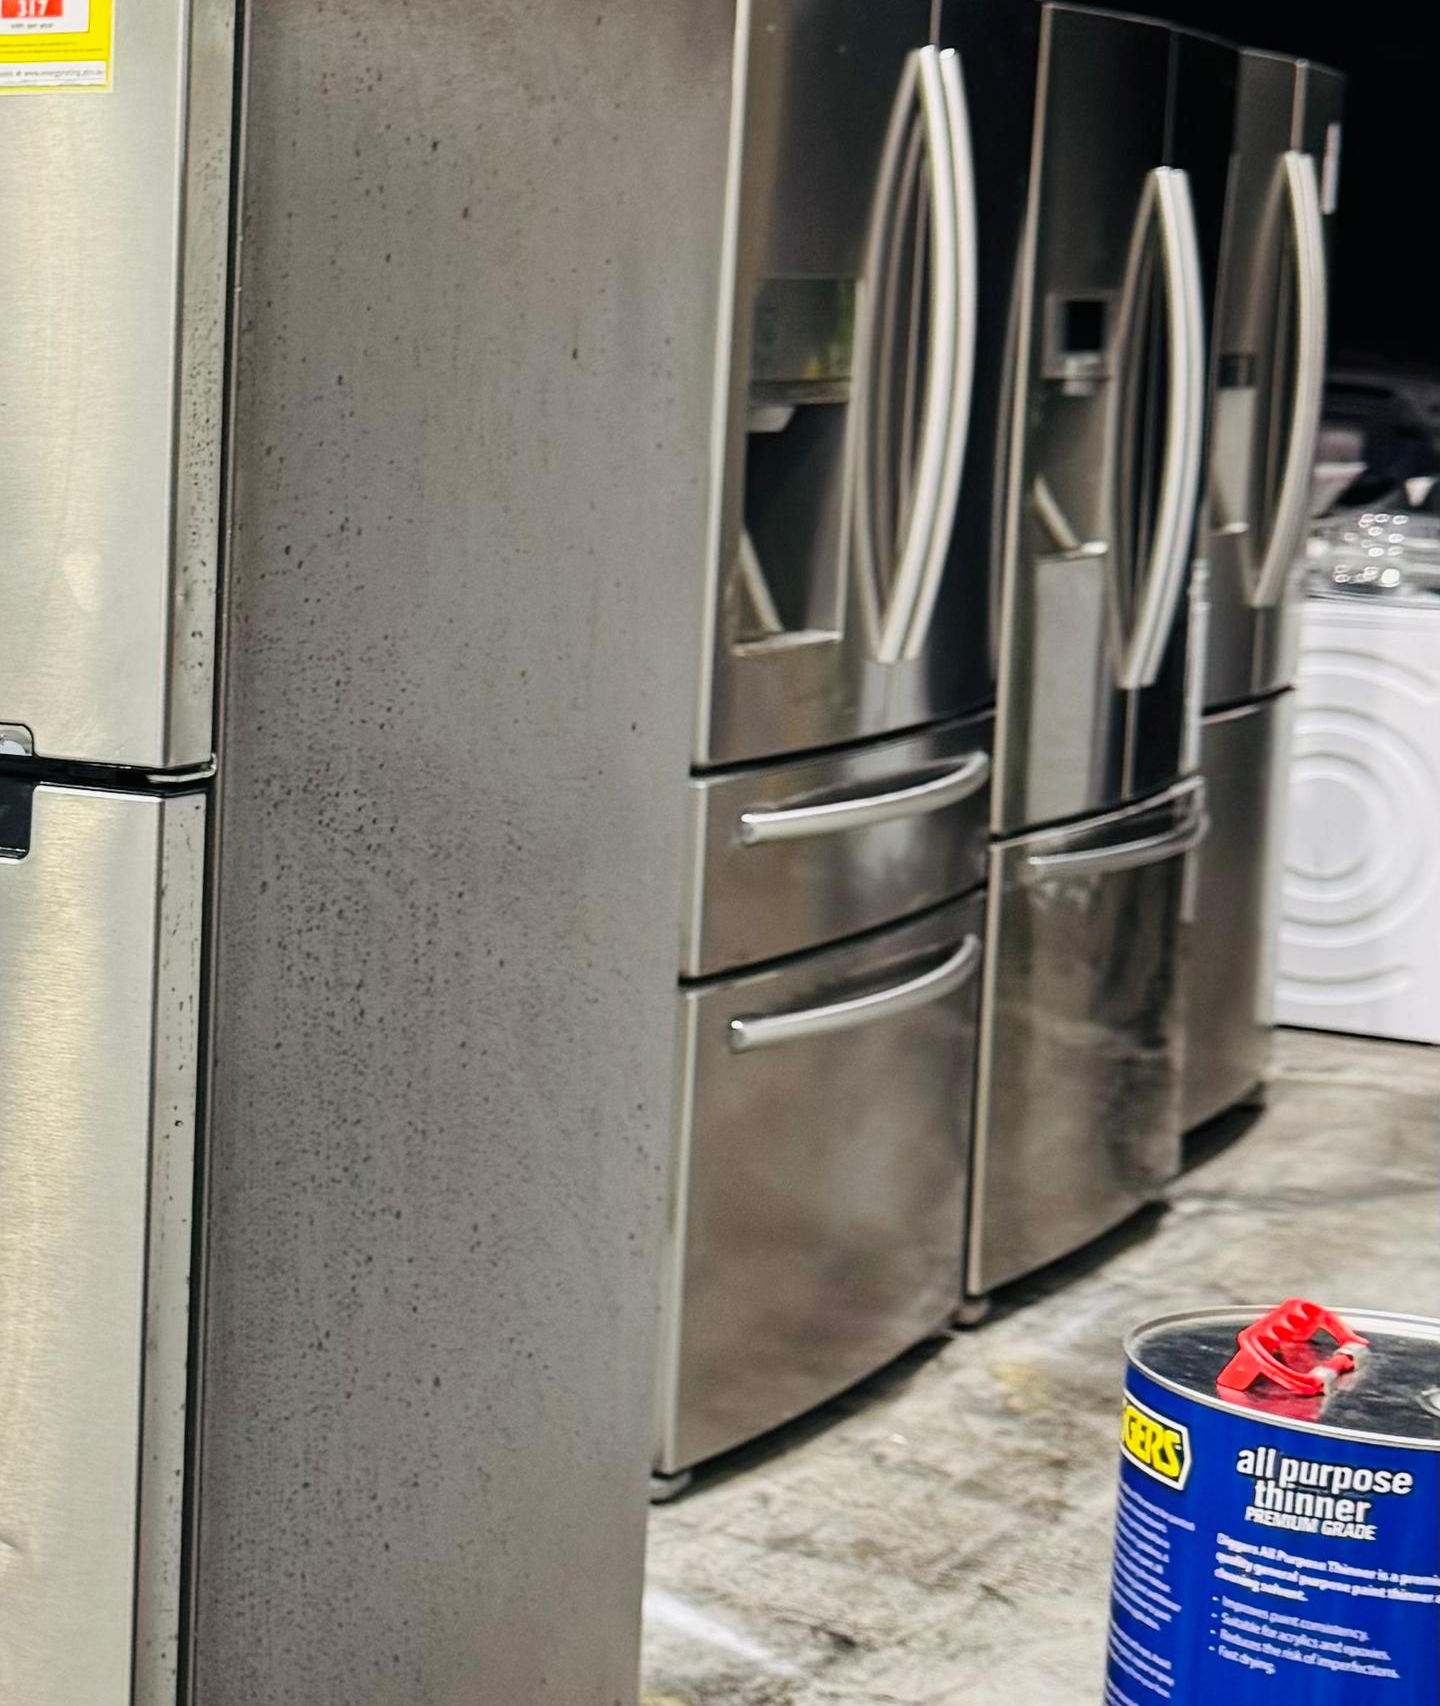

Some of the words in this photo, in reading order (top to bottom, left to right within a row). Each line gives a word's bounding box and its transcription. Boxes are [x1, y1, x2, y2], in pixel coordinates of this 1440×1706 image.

[1236, 1446, 1277, 1478] all
[1279, 1458, 1414, 1495] purpose
[1253, 1480, 1372, 1523] thinner
[1245, 1506, 1319, 1533] PREMIUM
[1320, 1520, 1378, 1541] GRADE
